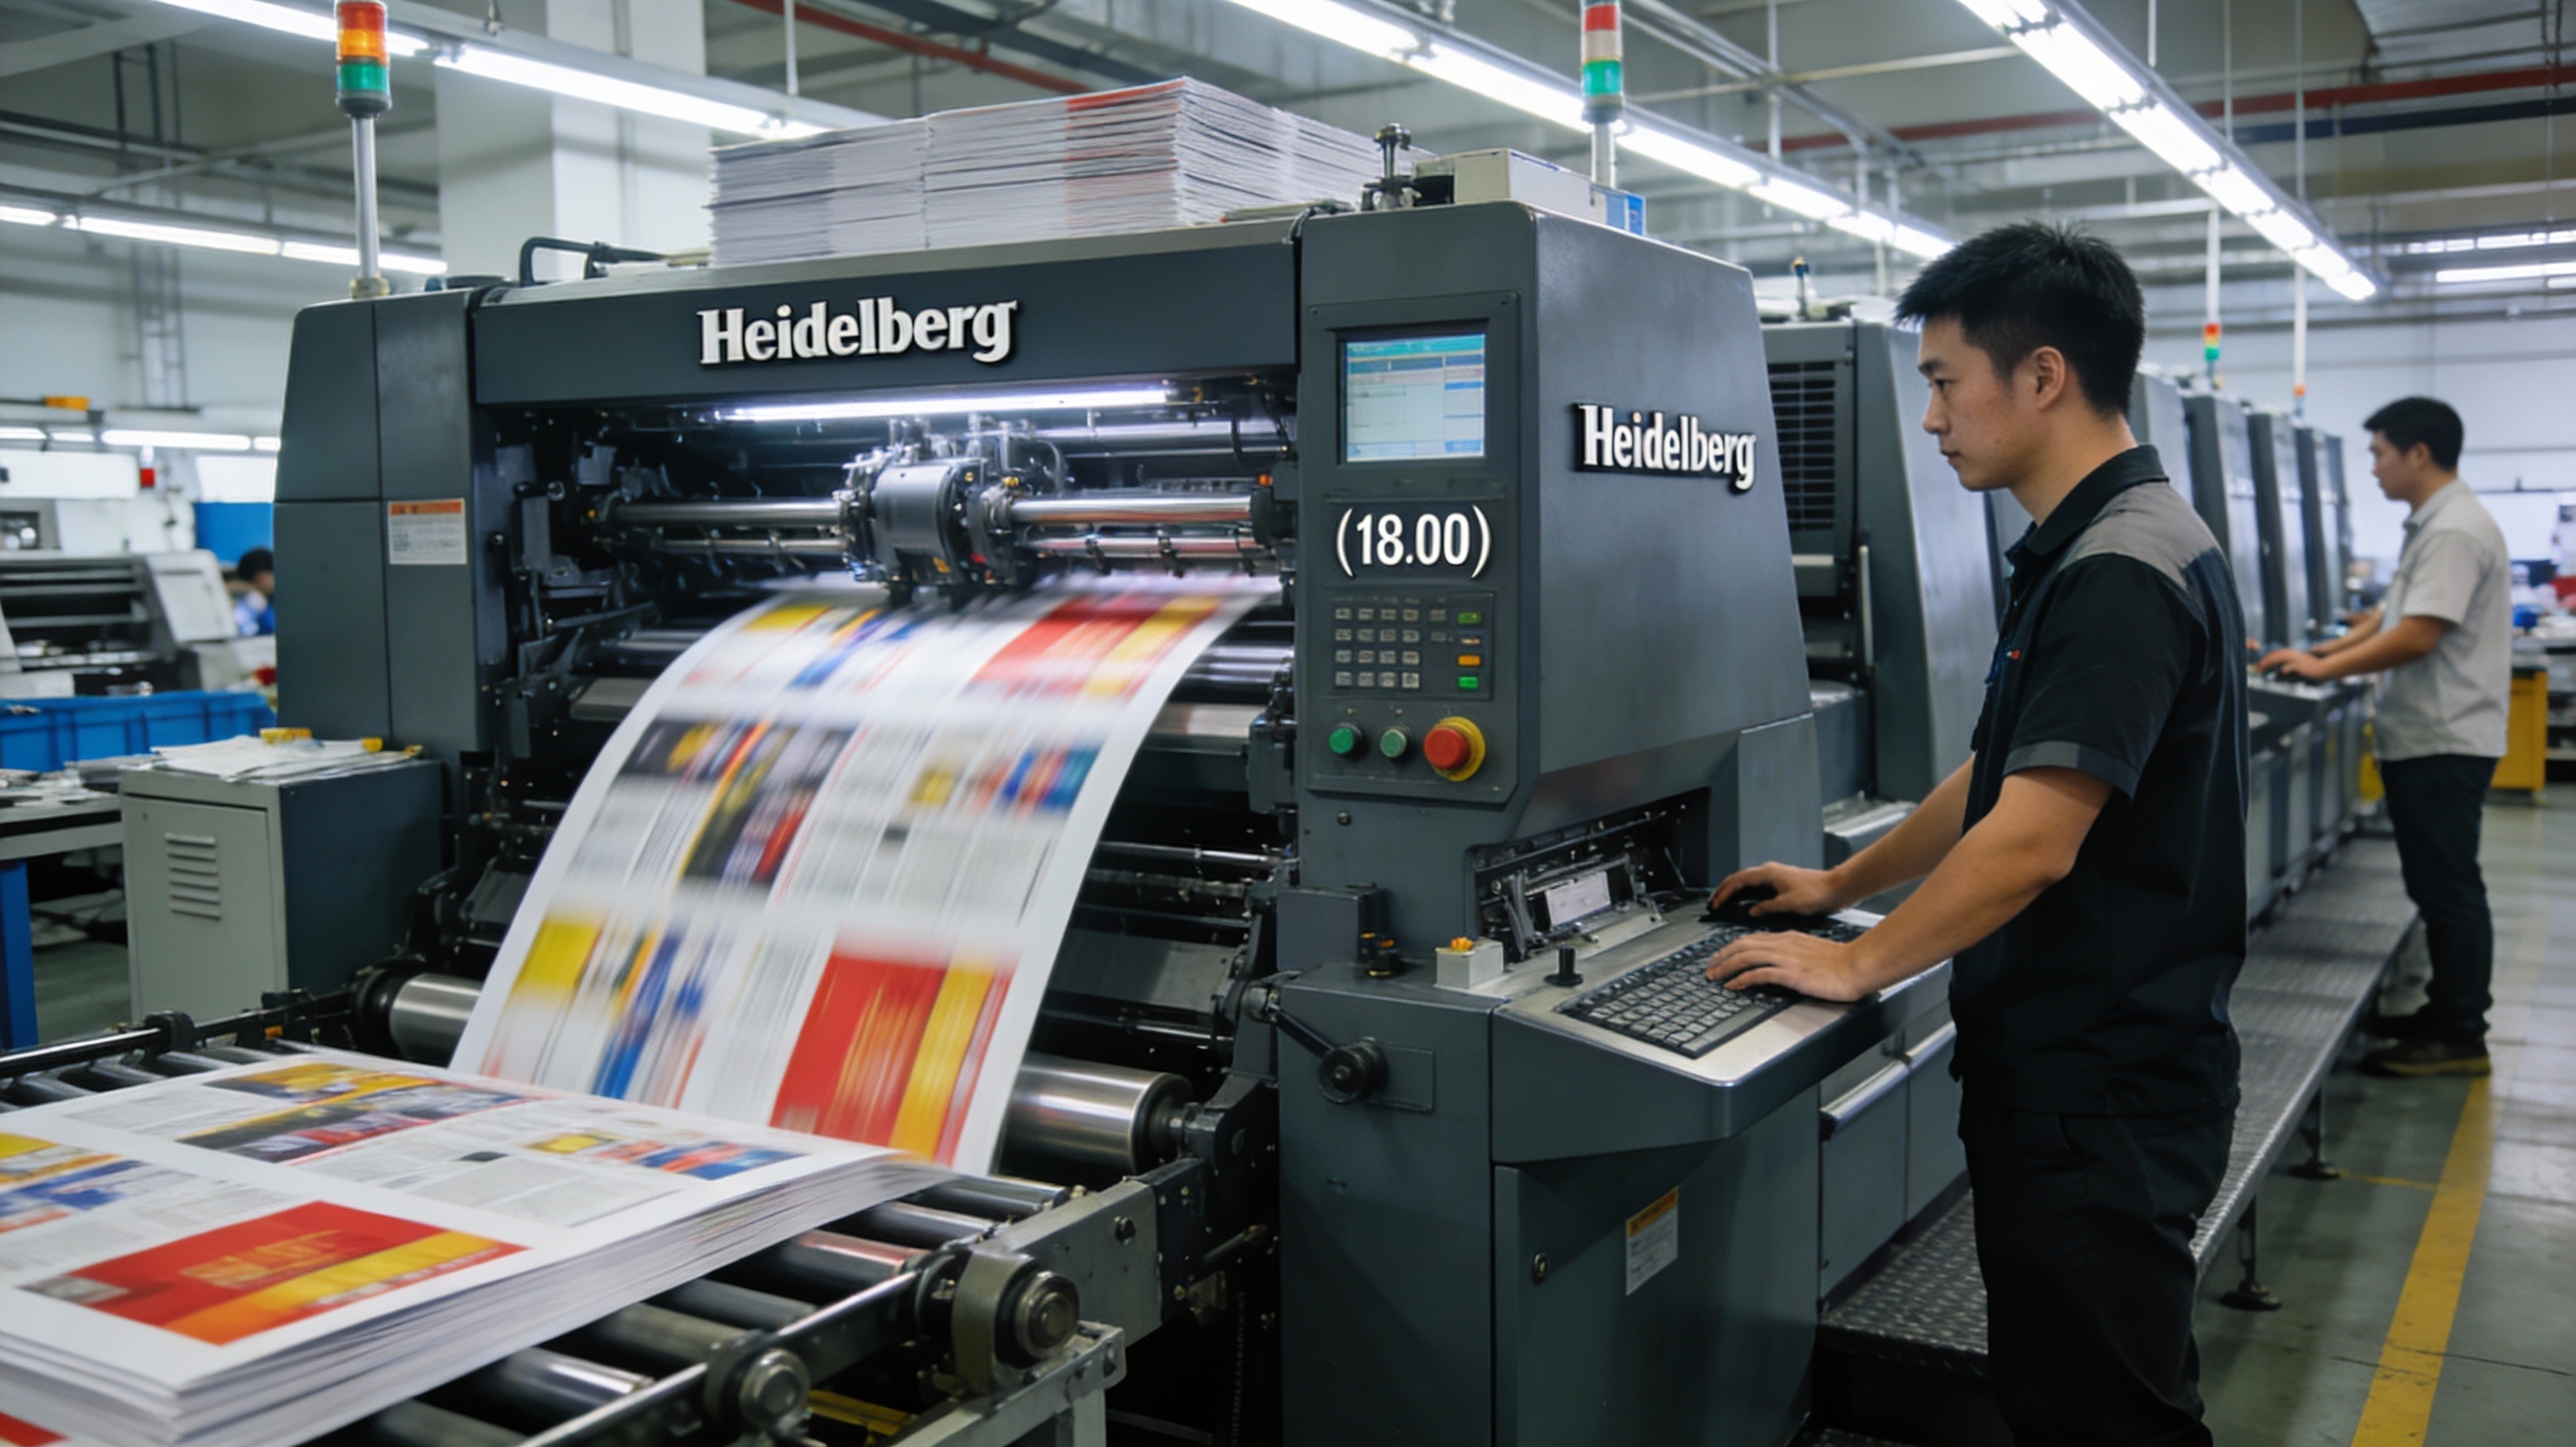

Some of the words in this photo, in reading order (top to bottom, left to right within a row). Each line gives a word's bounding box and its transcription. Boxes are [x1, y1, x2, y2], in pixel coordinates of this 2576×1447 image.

[697, 297, 1018, 364] Heidelberg
[1578, 403, 1757, 491] Heidelberg
[1336, 505, 1492, 579] (18.00)
